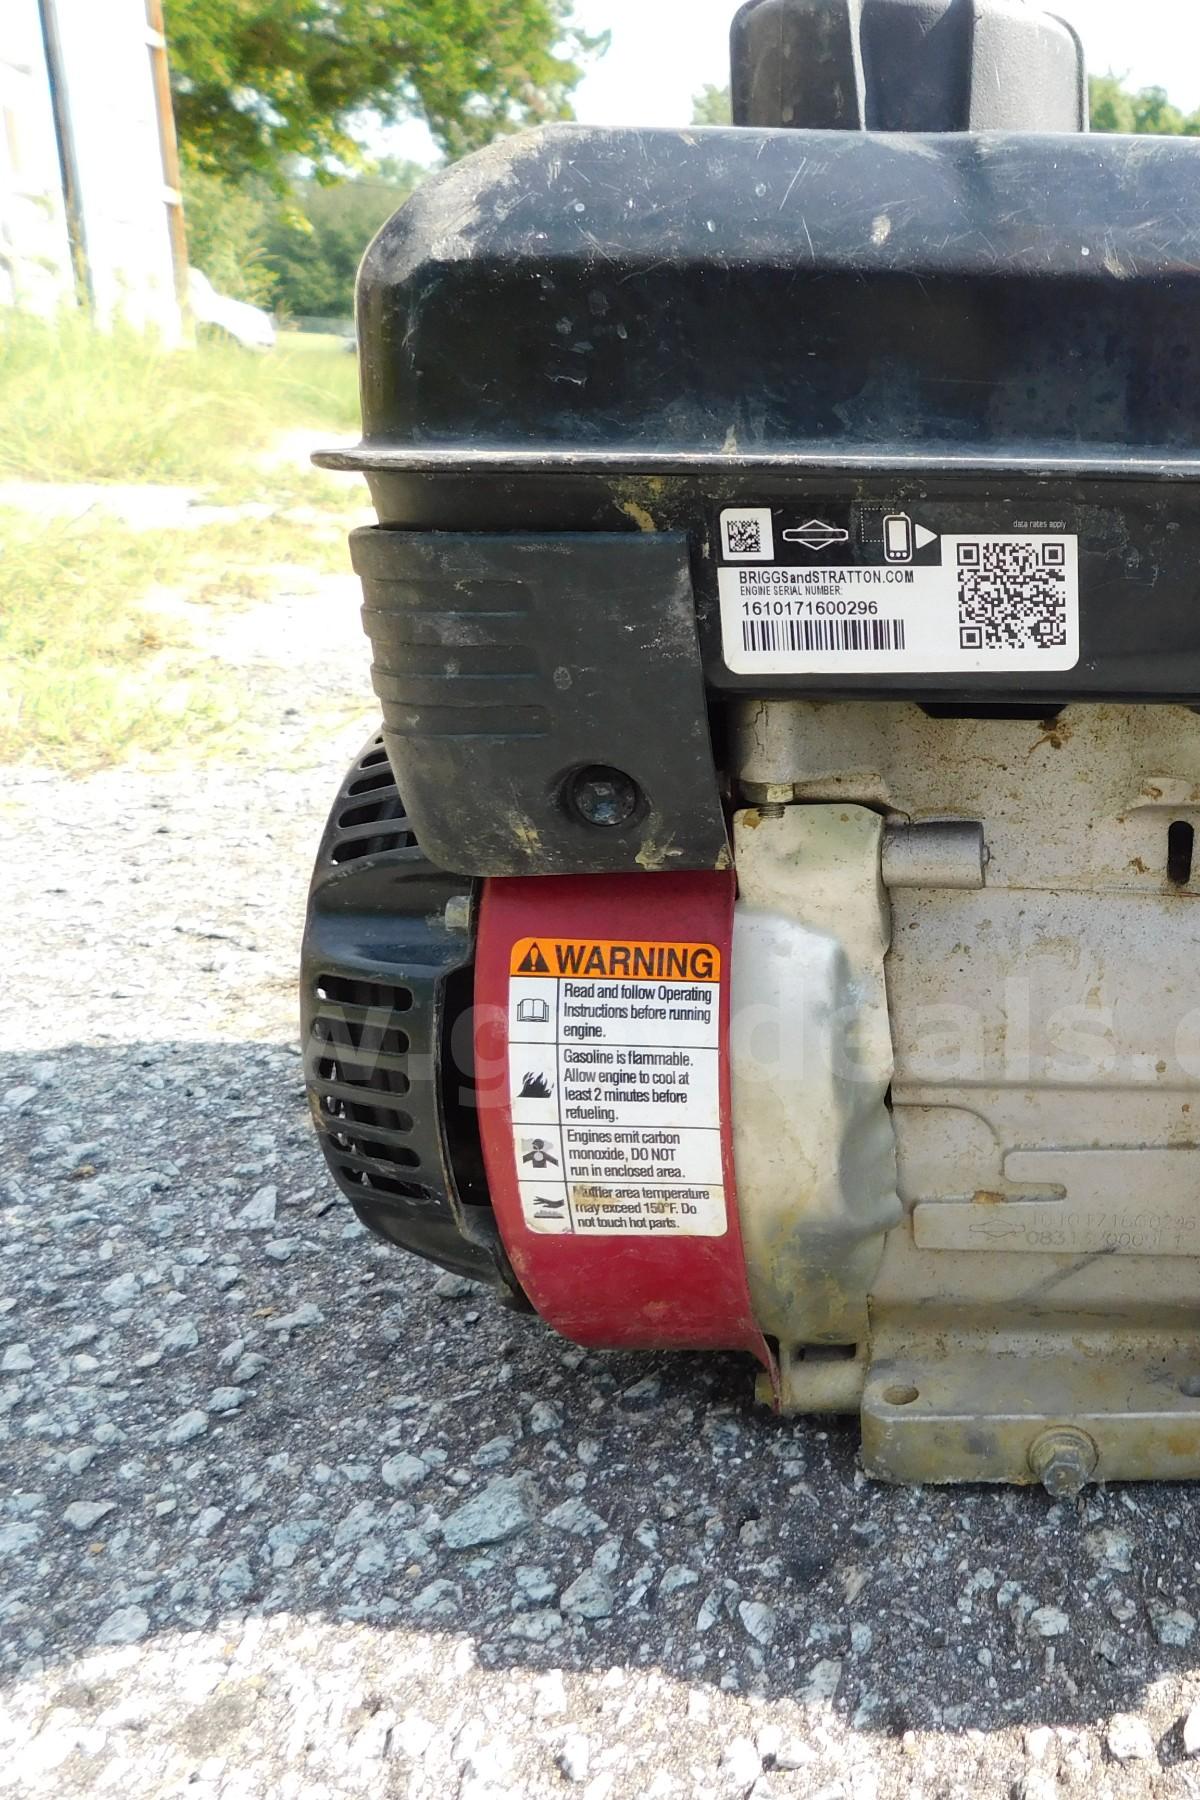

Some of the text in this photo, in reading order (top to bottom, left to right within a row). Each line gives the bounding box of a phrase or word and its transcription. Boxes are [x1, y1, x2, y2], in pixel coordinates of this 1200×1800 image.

[1030, 520, 1048, 528] rates
[739, 570, 914, 584] BRIGGSandSTRATTON.COM
[740, 585, 771, 596] ENGINE
[773, 585, 803, 596] SERIAL
[742, 601, 878, 615] 1610171600296
[554, 943, 714, 979] WARNING
[564, 984, 712, 1005] Read and follow Operating
[564, 1002, 711, 1024] Instructions before running
[564, 1024, 606, 1040] engine.
[564, 1050, 694, 1067] Gasoline is flammable.
[564, 1068, 690, 1087] Allow engine to cool at
[565, 1087, 687, 1104] least 2 minutes before
[566, 1106, 619, 1122] refueling.
[567, 1130, 680, 1147] Engines emit carbon
[569, 1147, 676, 1163] monoxide, DO NOT
[570, 1164, 685, 1178] run in enclosed area.
[615, 1187, 641, 1199] area
[643, 1187, 709, 1201] temperature
[576, 1203, 601, 1216] may
[603, 1202, 642, 1214] exceed
[681, 1203, 697, 1215] Do
[578, 1216, 680, 1230] not touch hot parts.
